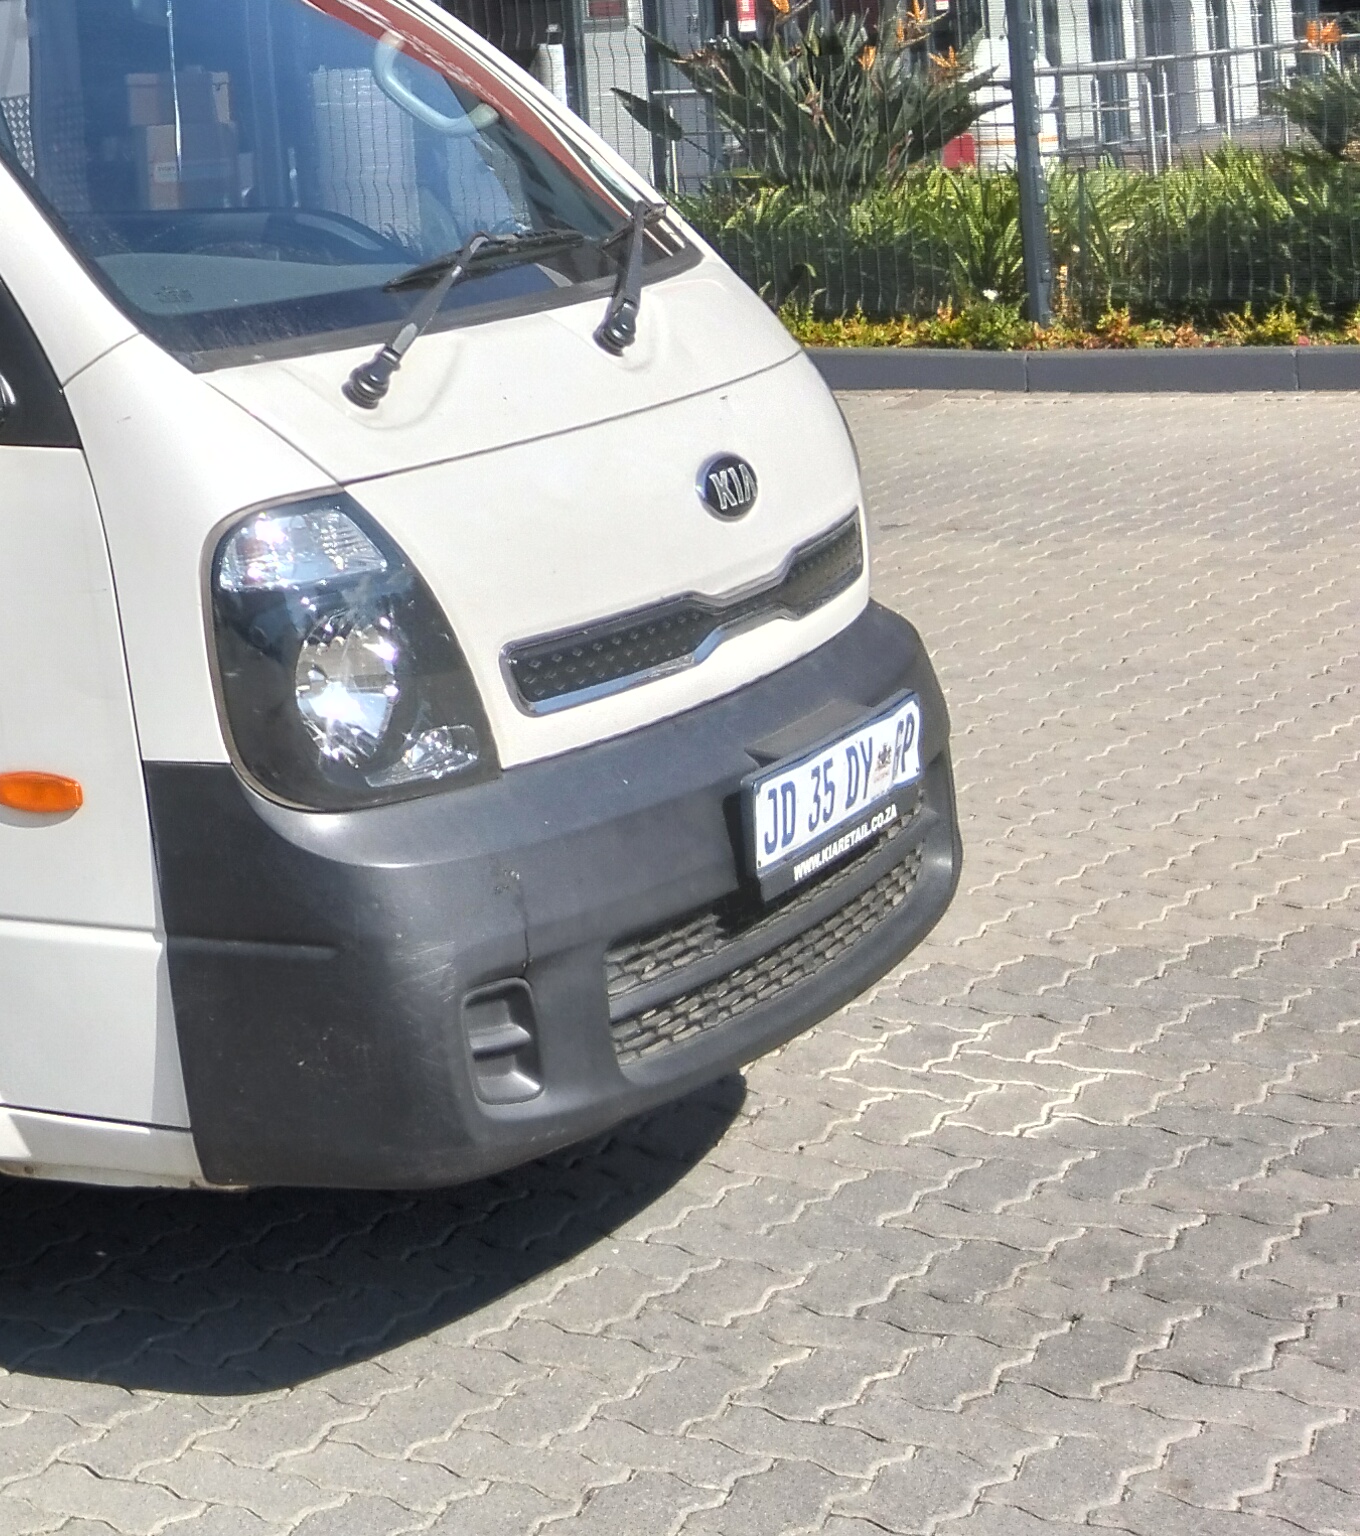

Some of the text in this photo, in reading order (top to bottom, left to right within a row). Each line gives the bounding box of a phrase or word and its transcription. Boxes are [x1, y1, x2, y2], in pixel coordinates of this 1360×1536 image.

[709, 464, 758, 510] KIA
[763, 780, 797, 855] JD
[808, 758, 835, 832] 35
[844, 736, 874, 810] DY
[793, 803, 898, 882] WWW.KIARETAIL.CO.ZA
